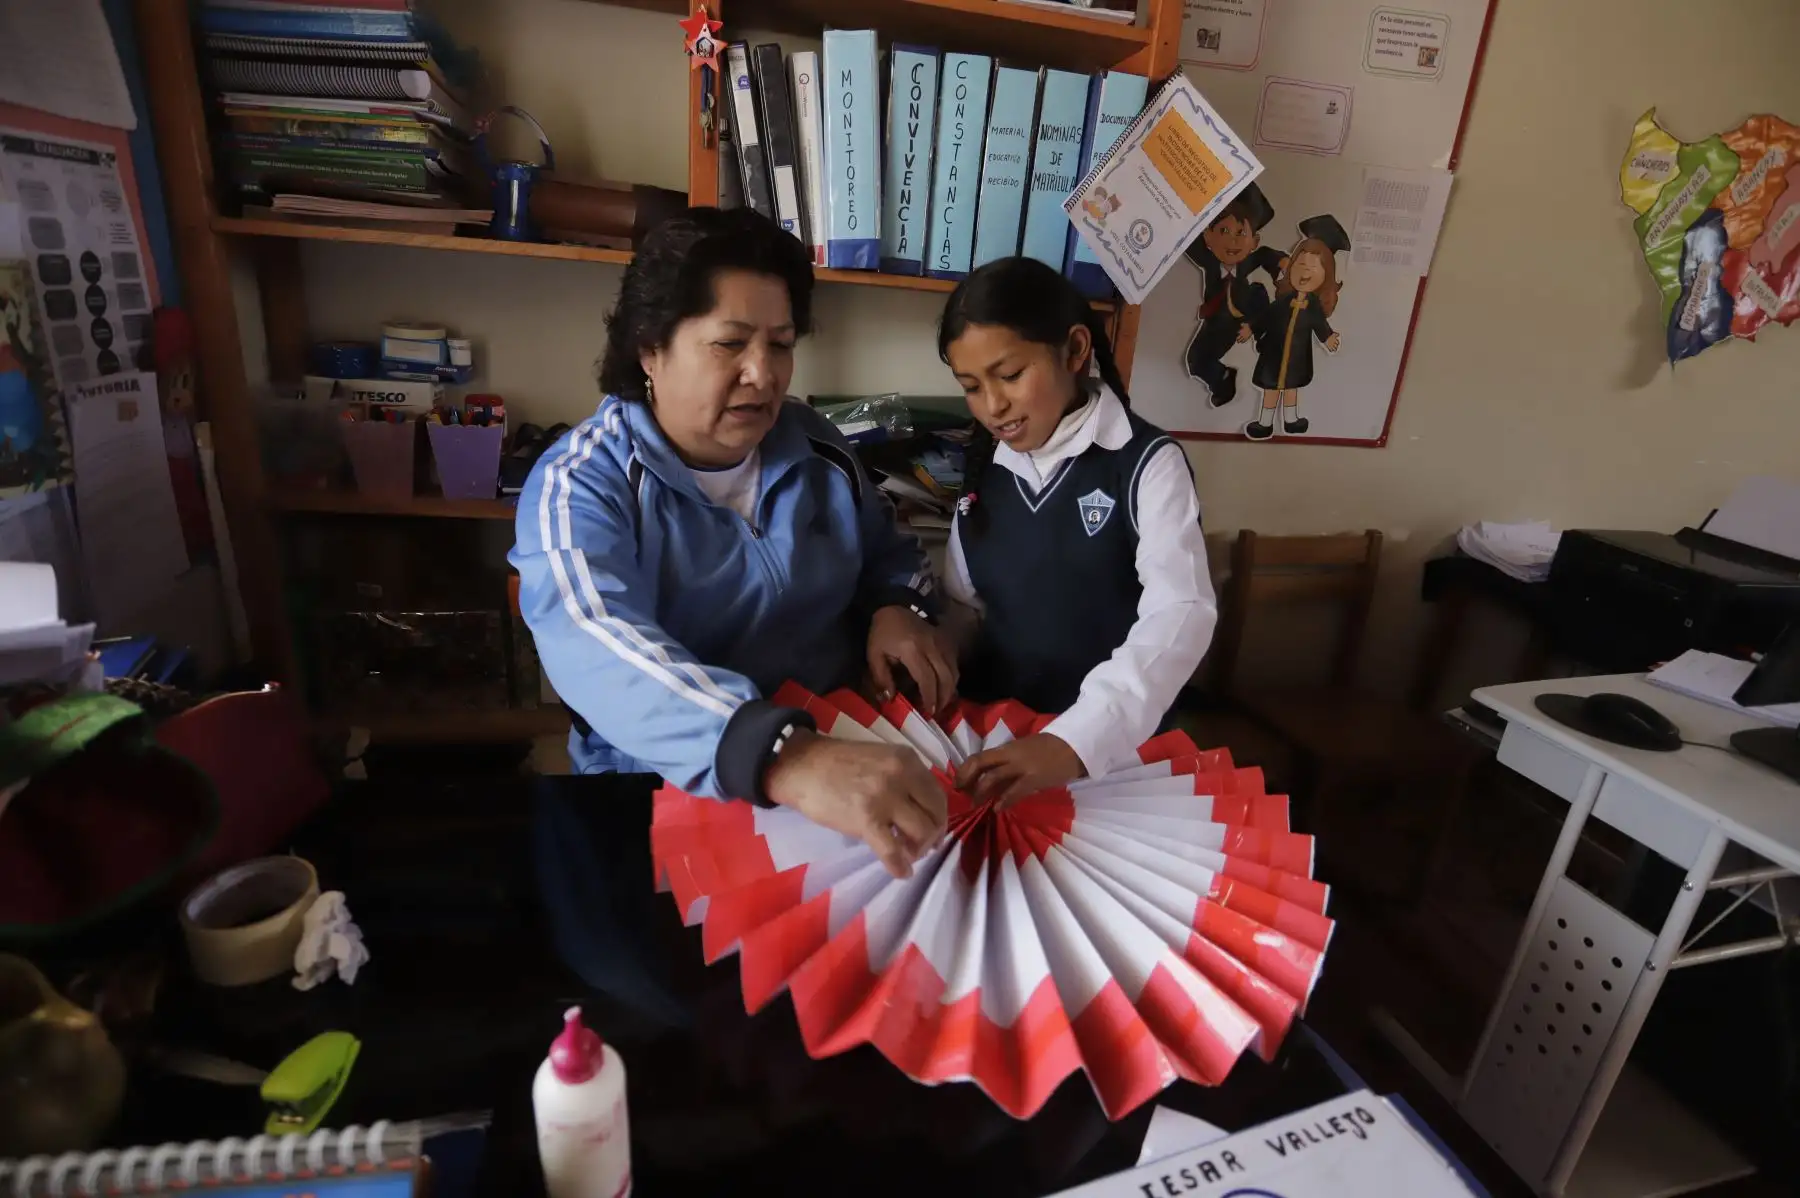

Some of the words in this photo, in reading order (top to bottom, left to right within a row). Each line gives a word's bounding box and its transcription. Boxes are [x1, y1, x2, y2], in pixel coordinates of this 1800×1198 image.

[991, 126, 1025, 138] MATERIAL
[841, 69, 858, 231] MONITOREO
[897, 63, 925, 254] CONVIVENCIA
[939, 60, 969, 270] CONSTANCIAS
[988, 153, 1021, 164] EDUCATIVO
[1049, 151, 1063, 166] DE
[987, 176, 1019, 188] RECIBIDO
[1265, 1106, 1376, 1157] VALLEJO
